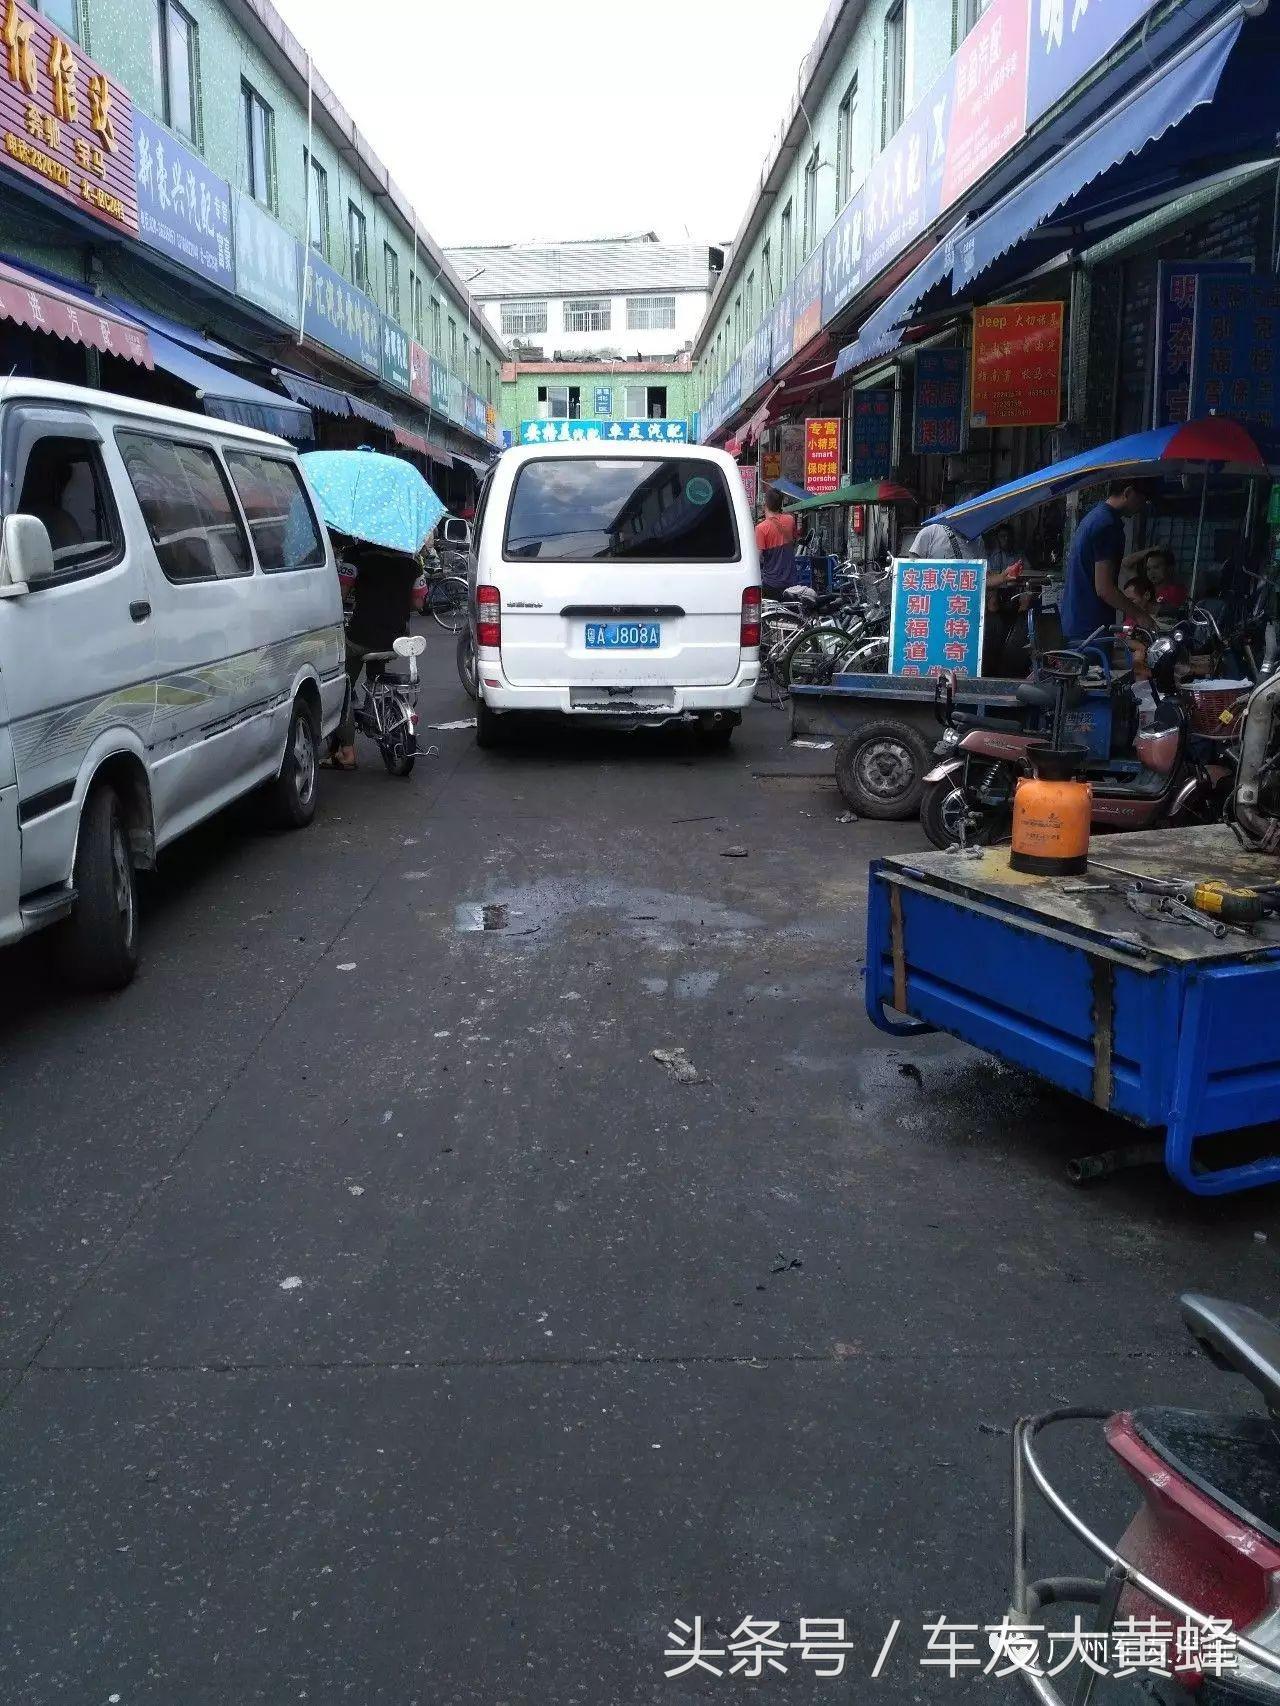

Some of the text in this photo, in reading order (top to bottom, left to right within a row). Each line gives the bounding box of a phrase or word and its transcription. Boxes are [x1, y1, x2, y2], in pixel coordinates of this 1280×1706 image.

[74, 137, 107, 181] 宝马
[978, 315, 1007, 330] Jeep
[809, 421, 838, 435] 专营
[807, 438, 838, 450] 小精灵
[807, 462, 838, 475] 保时捷
[807, 475, 837, 484] porsche
[902, 568, 978, 592] 实惠汽配
[906, 594, 971, 616] 别克
[904, 618, 970, 639] 福特
[903, 641, 969, 663] 道奇
